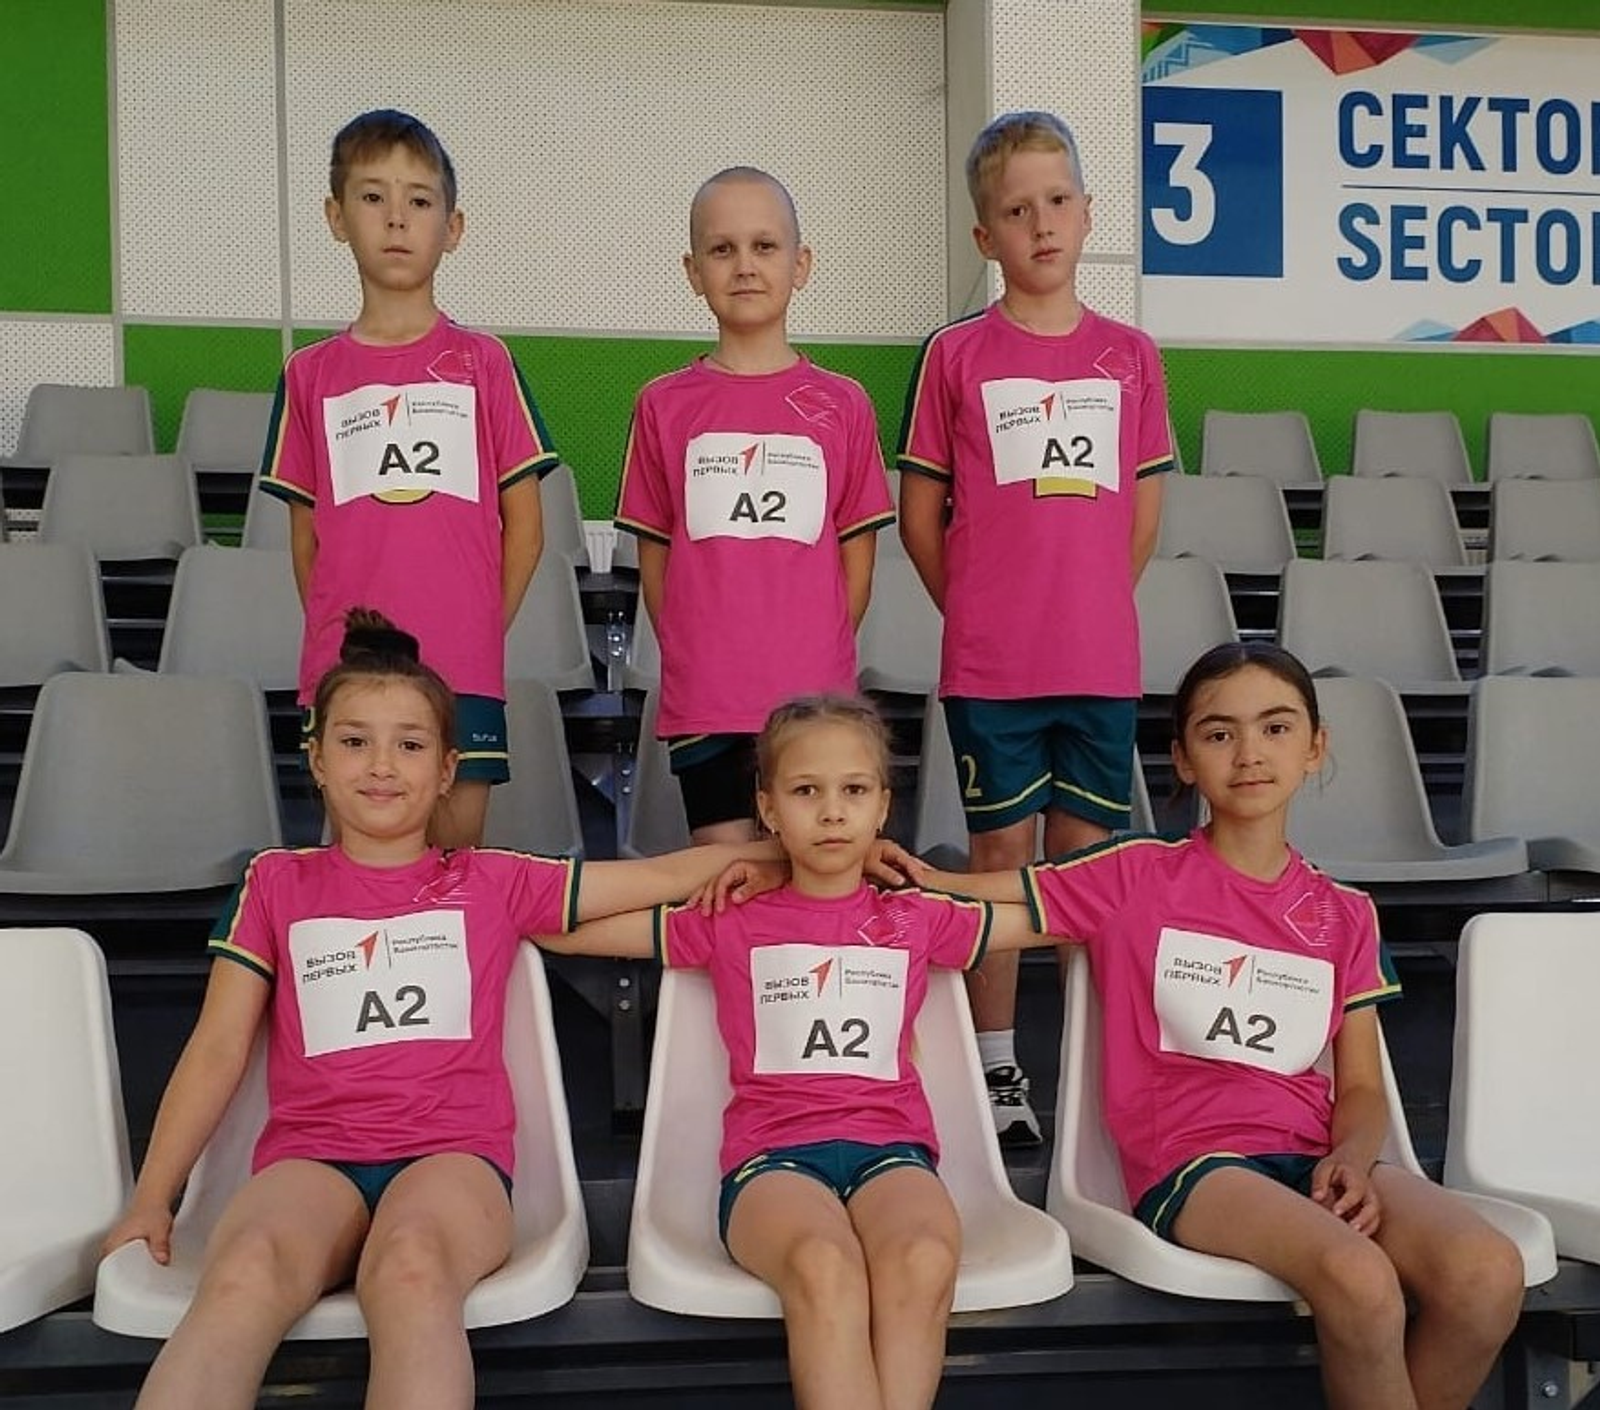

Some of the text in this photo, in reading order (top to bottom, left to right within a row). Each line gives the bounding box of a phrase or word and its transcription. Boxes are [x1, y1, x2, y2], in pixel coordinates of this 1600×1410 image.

[1337, 90, 1600, 176] СЕКТО
[1151, 122, 1216, 245] 3
[1336, 202, 1600, 286] SECTO
